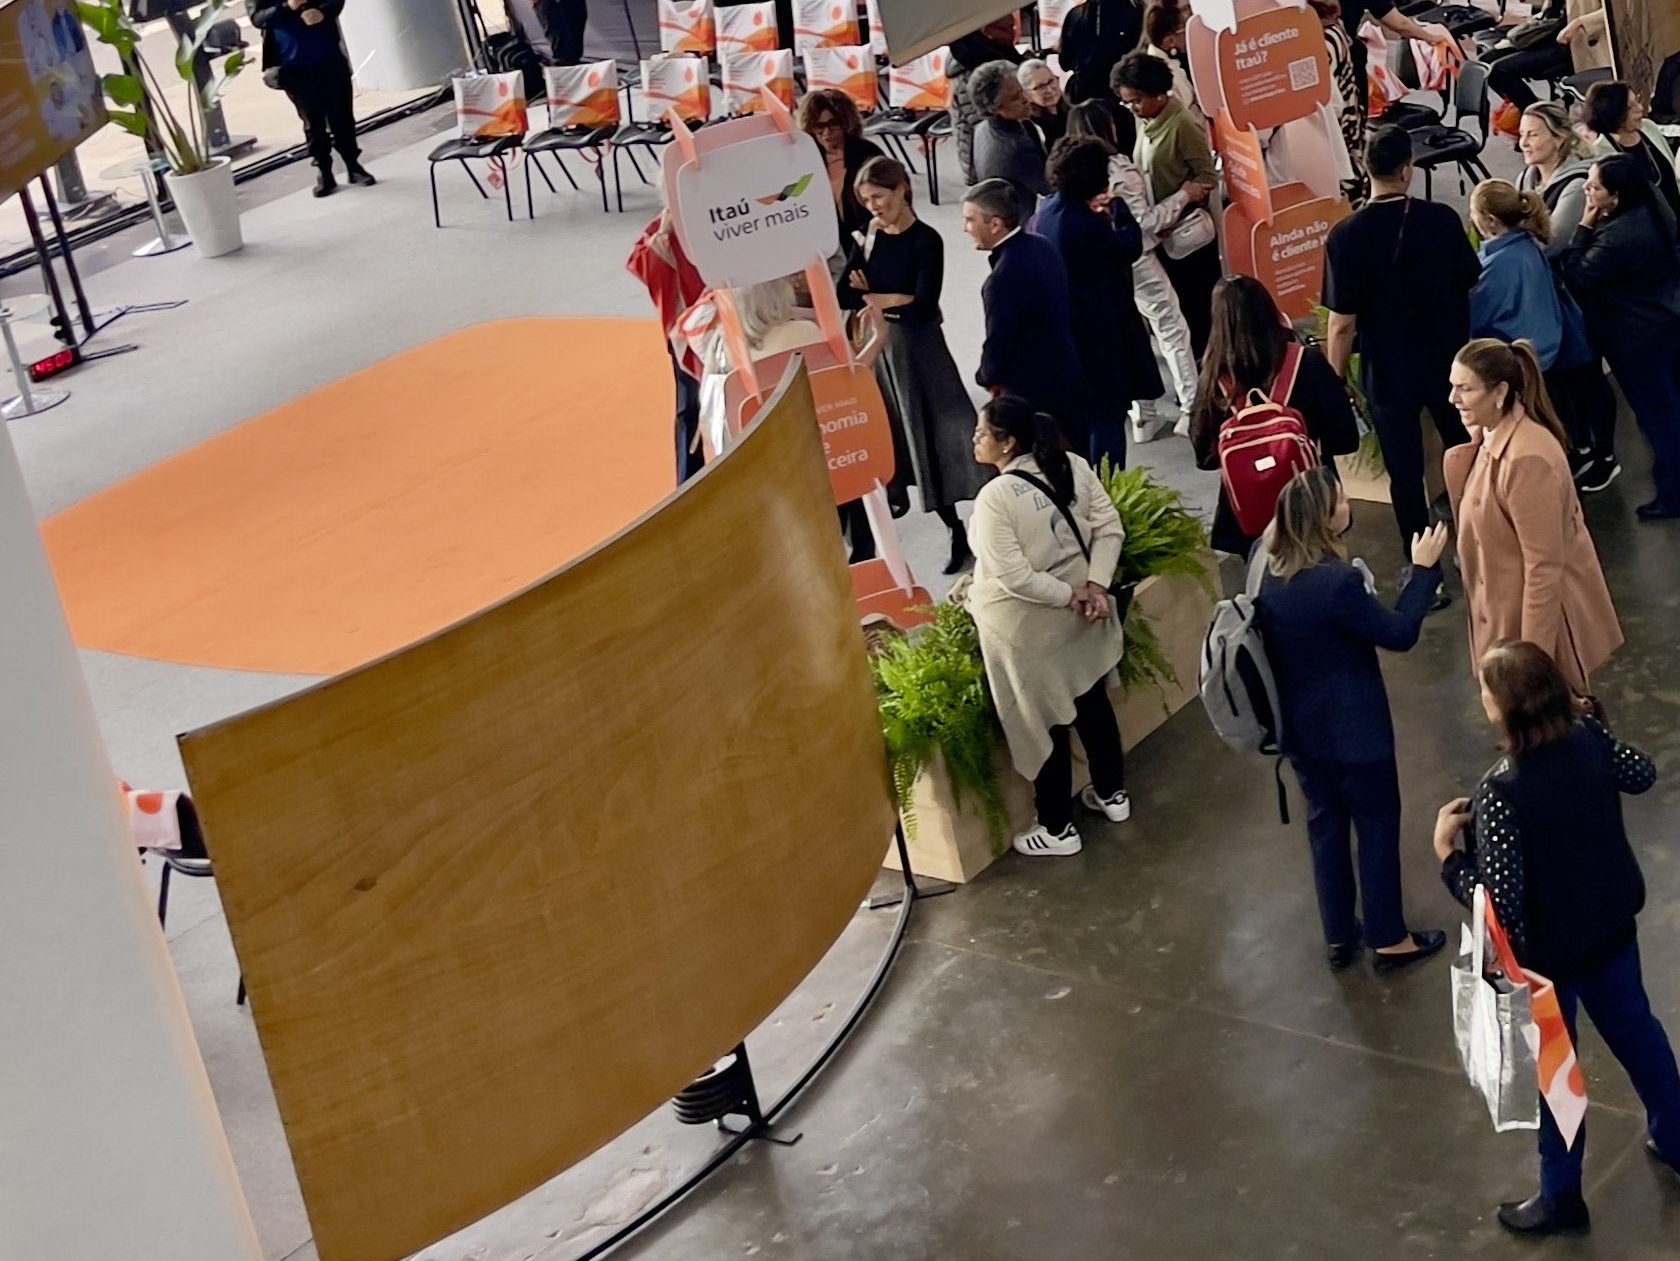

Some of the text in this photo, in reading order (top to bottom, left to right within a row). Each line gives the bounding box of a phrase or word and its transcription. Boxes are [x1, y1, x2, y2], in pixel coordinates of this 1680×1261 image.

[1233, 27, 1300, 56] Já é cliente
[1235, 50, 1268, 71] Itaú?
[708, 197, 751, 224] Itaú
[712, 202, 810, 242] viver mais
[1269, 220, 1329, 248] Ainda não
[1271, 248, 1281, 262] é
[1280, 240, 1319, 259] cliente
